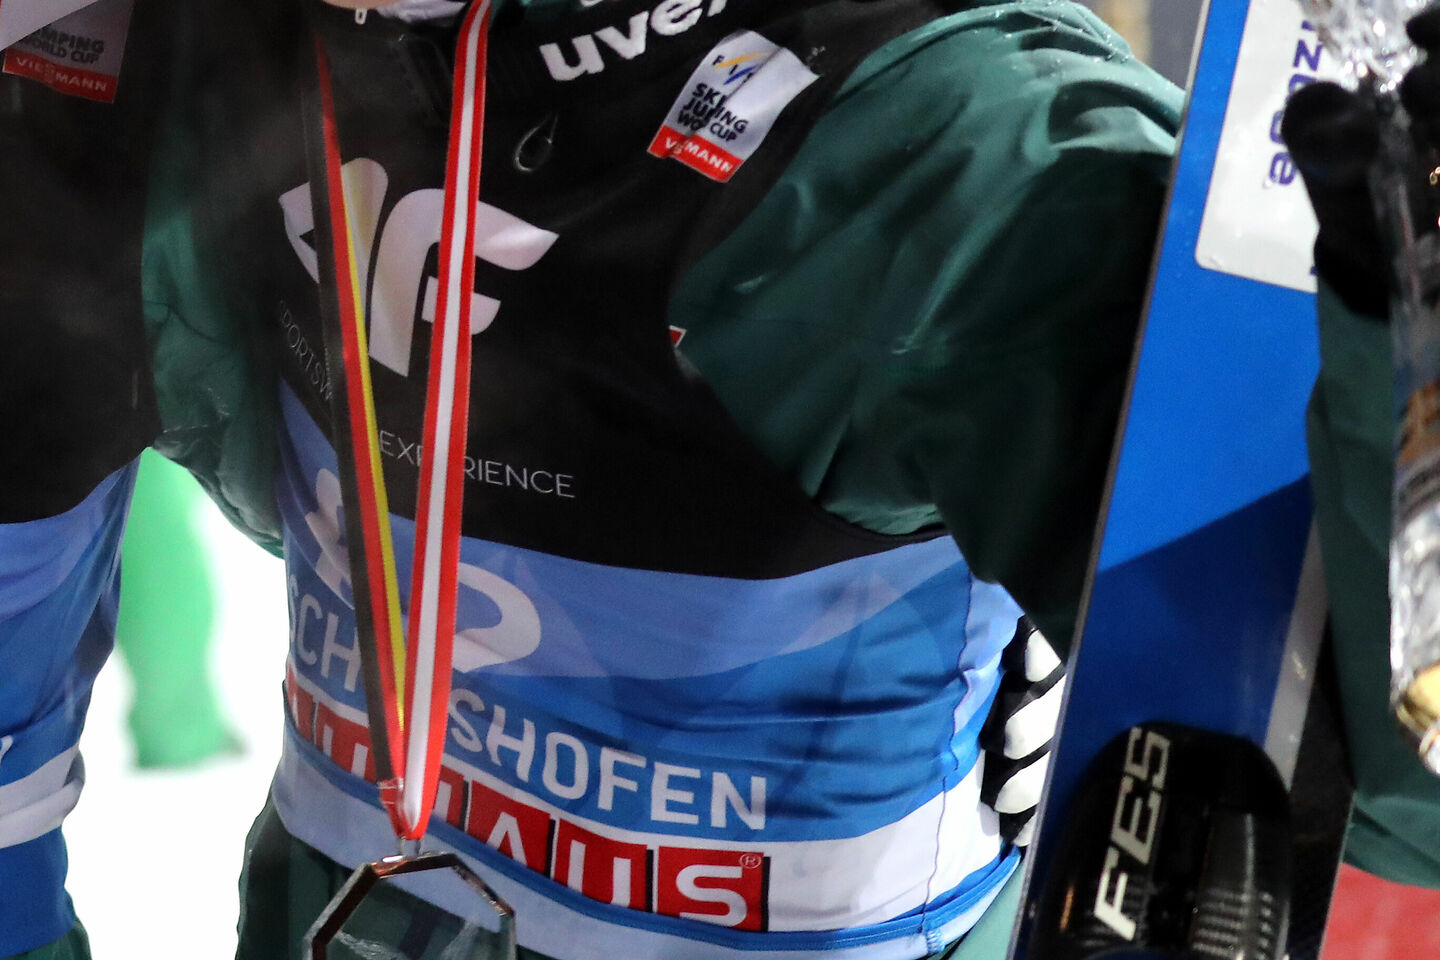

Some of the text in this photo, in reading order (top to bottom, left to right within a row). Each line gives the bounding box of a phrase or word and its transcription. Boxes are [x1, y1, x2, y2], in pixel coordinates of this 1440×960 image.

[710, 122, 738, 143] CUP
[380, 429, 575, 498] EXRIENCE
[1094, 726, 1170, 941] FES
